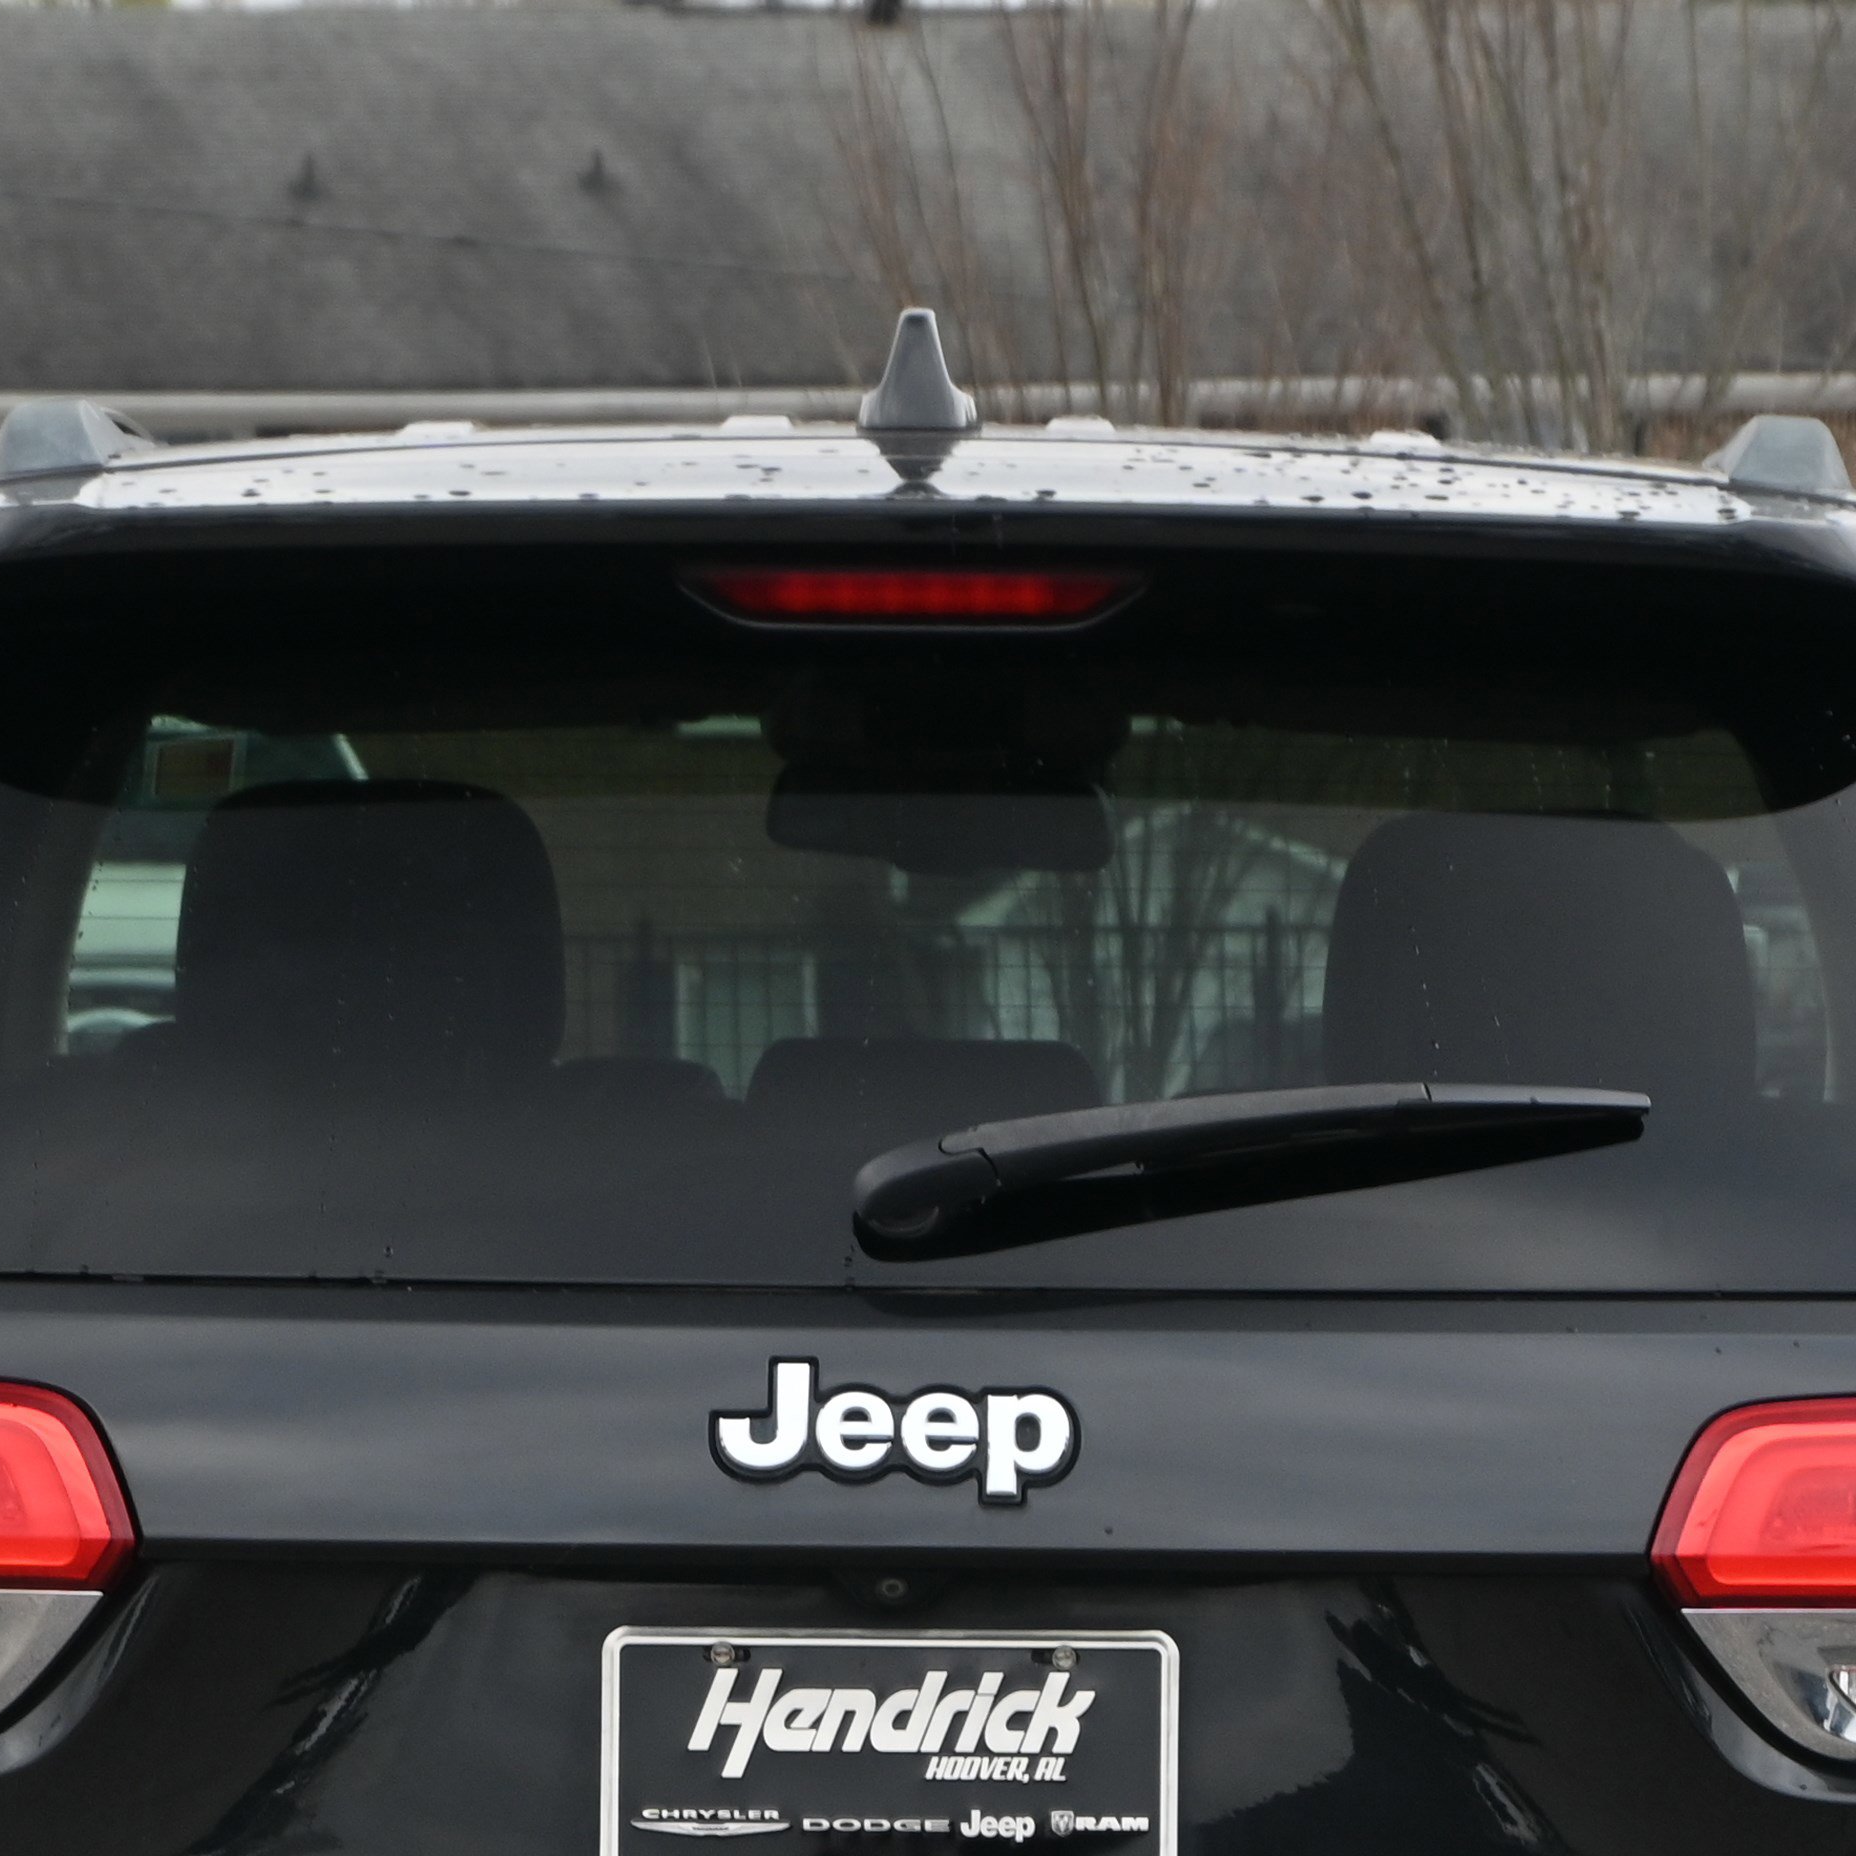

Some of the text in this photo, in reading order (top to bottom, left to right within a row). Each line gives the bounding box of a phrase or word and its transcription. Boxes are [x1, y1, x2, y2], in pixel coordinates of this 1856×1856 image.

[717, 1361, 1071, 1496] Jeep
[687, 1667, 1096, 1779] Hendrick
[925, 1756, 1067, 1784] HOOVER, AL
[642, 1808, 780, 1820] CHRYSLER
[802, 1818, 950, 1832] DODGE
[960, 1810, 1036, 1842] Jeep
[1075, 1816, 1150, 1832] RAM
